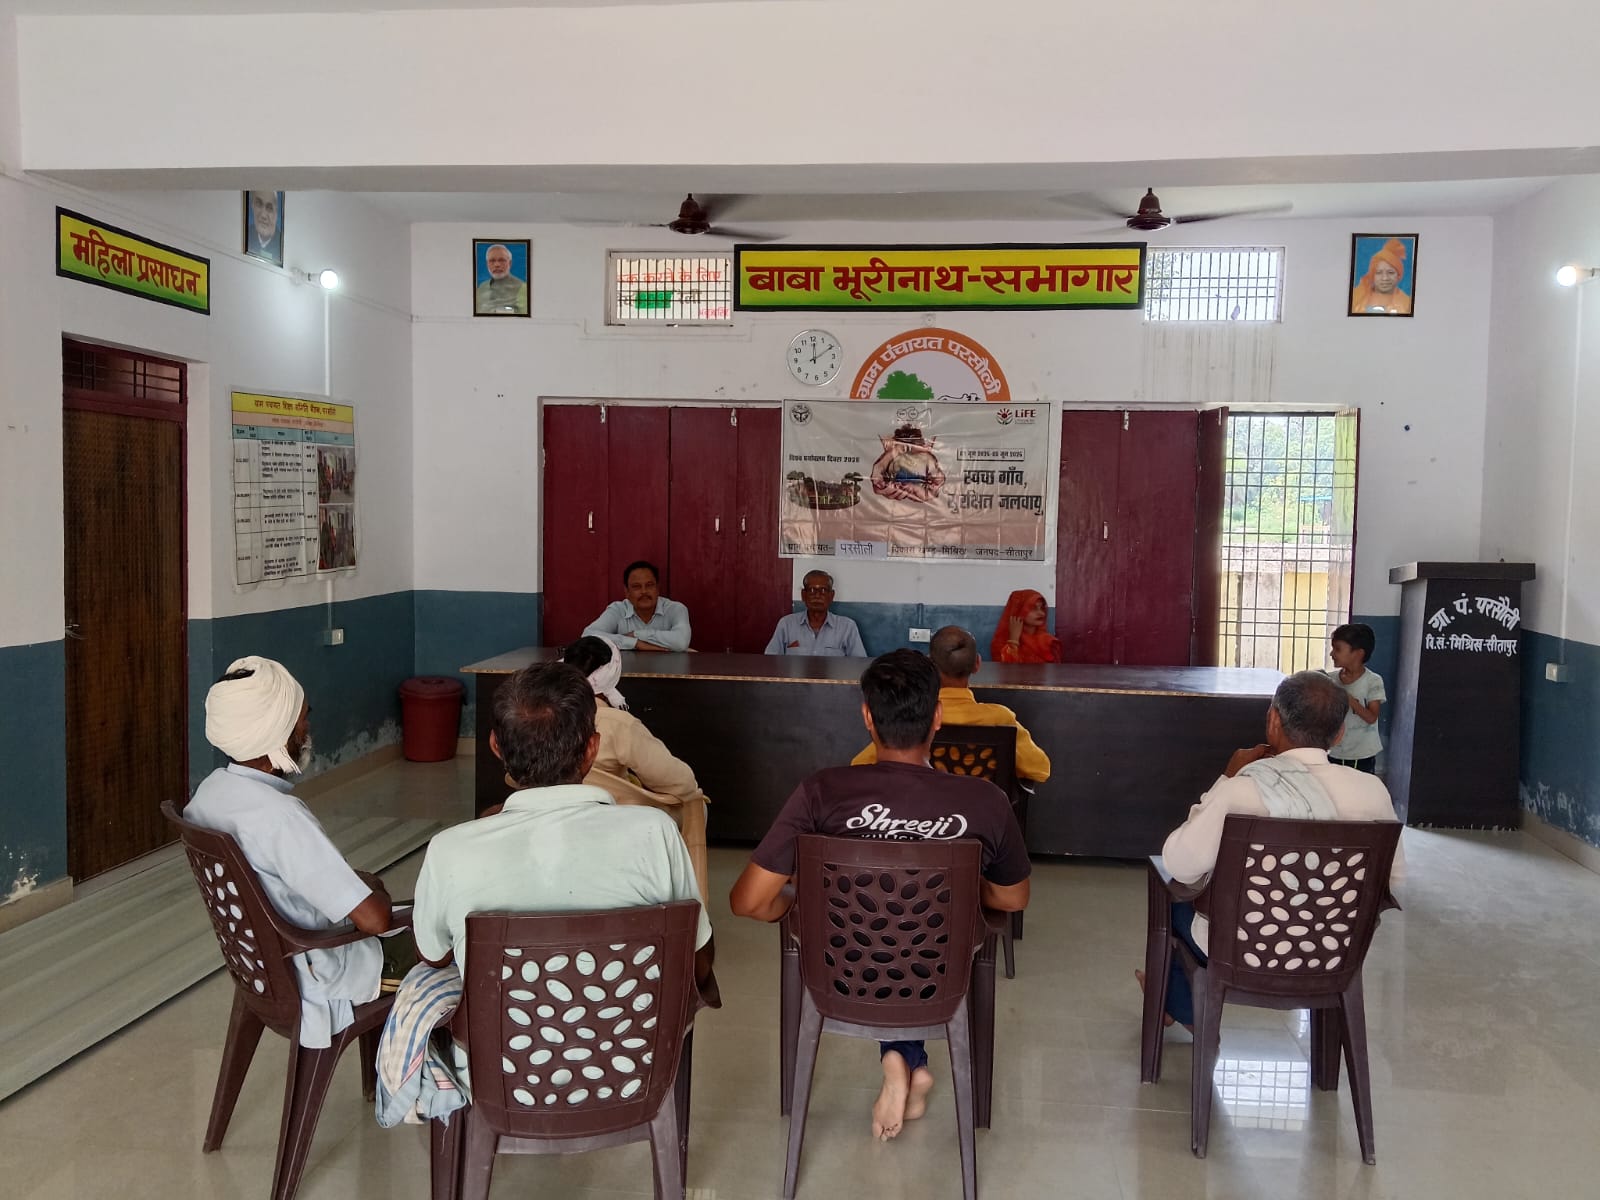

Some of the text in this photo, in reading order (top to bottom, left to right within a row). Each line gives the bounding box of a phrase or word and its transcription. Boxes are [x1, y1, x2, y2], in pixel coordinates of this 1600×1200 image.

[70, 228, 201, 297] महिला प्रसाधन
[745, 265, 826, 292] बाबा
[809, 335, 817, 343] 12
[797, 366, 802, 374] 8
[856, 336, 1002, 399] ग्राम पंचायत परसौली
[1015, 408, 1037, 418] LiFE
[963, 469, 995, 486] स्वच्छ
[947, 490, 994, 514] सुरक्षित
[840, 541, 874, 557] परसौली
[1427, 592, 1521, 632] ग्रा. पं. परसौली
[846, 803, 968, 840] Shreeji
